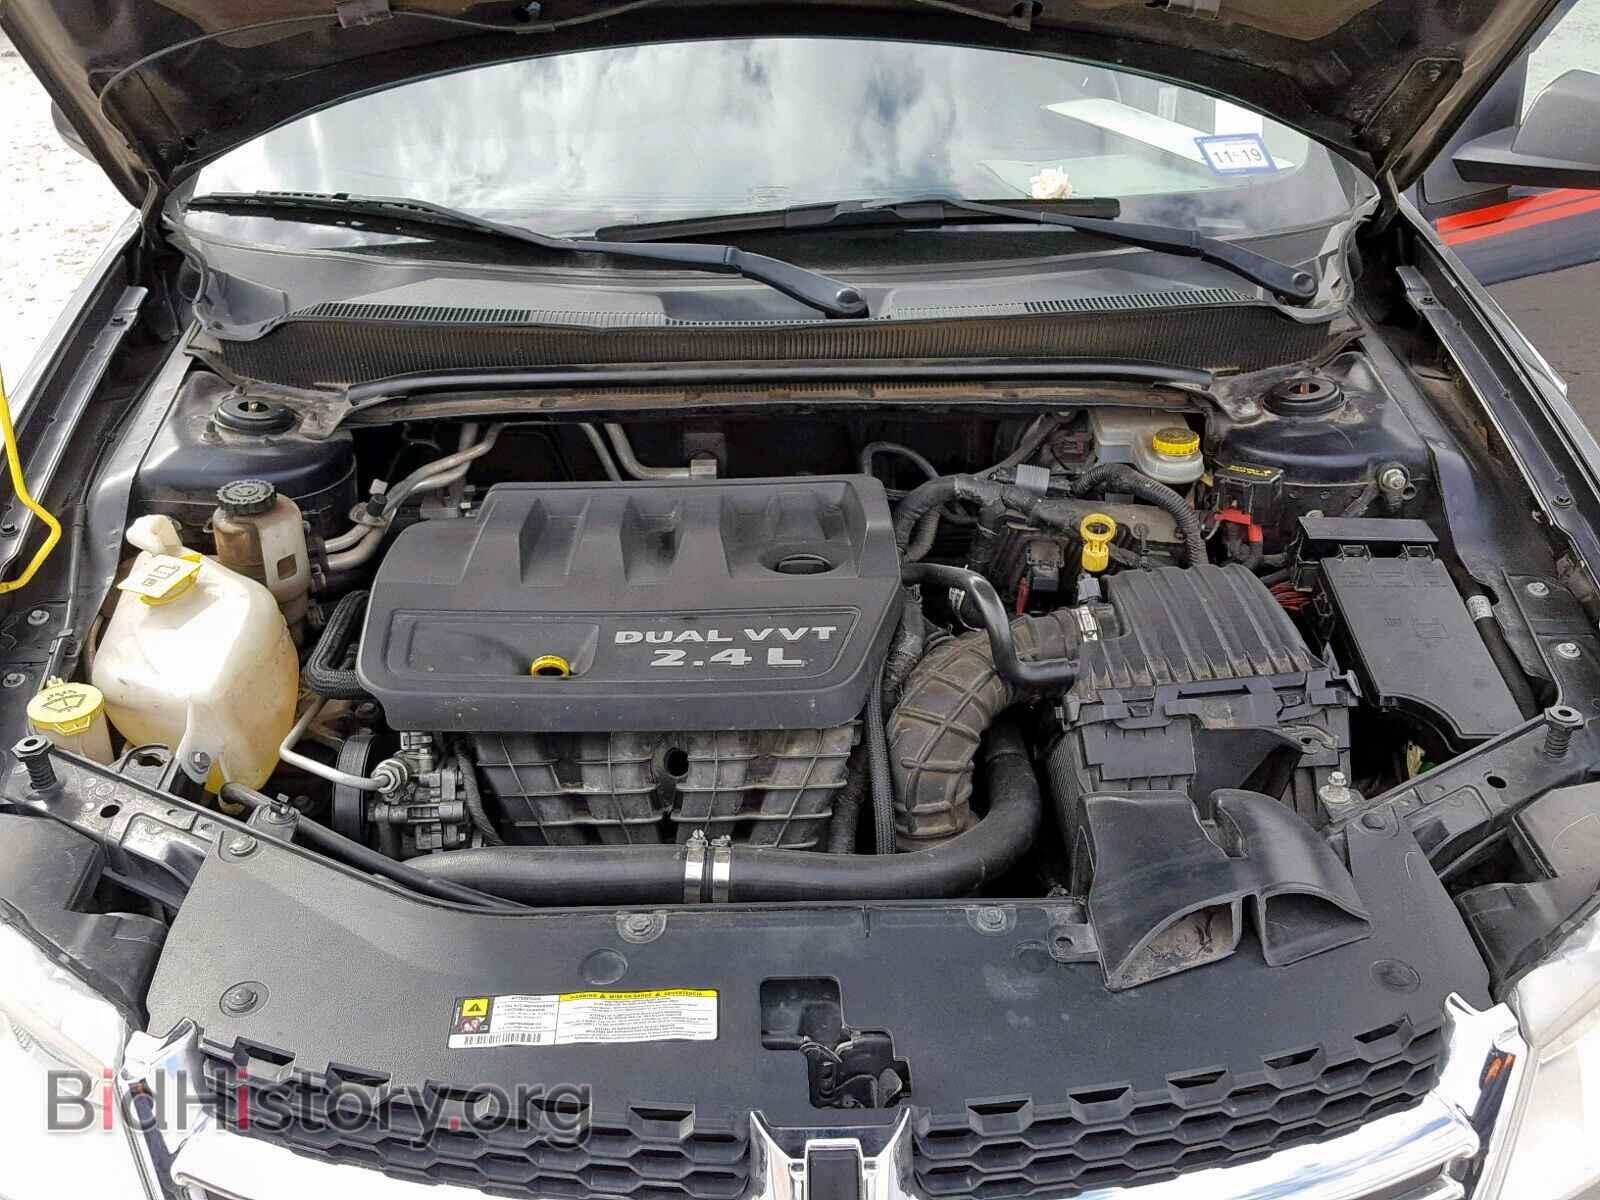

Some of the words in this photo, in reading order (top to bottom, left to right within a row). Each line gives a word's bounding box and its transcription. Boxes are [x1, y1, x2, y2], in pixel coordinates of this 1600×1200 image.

[614, 630, 734, 645] DUAL
[743, 626, 837, 642] VVT
[650, 649, 753, 667] 2.4
[767, 647, 803, 667] L
